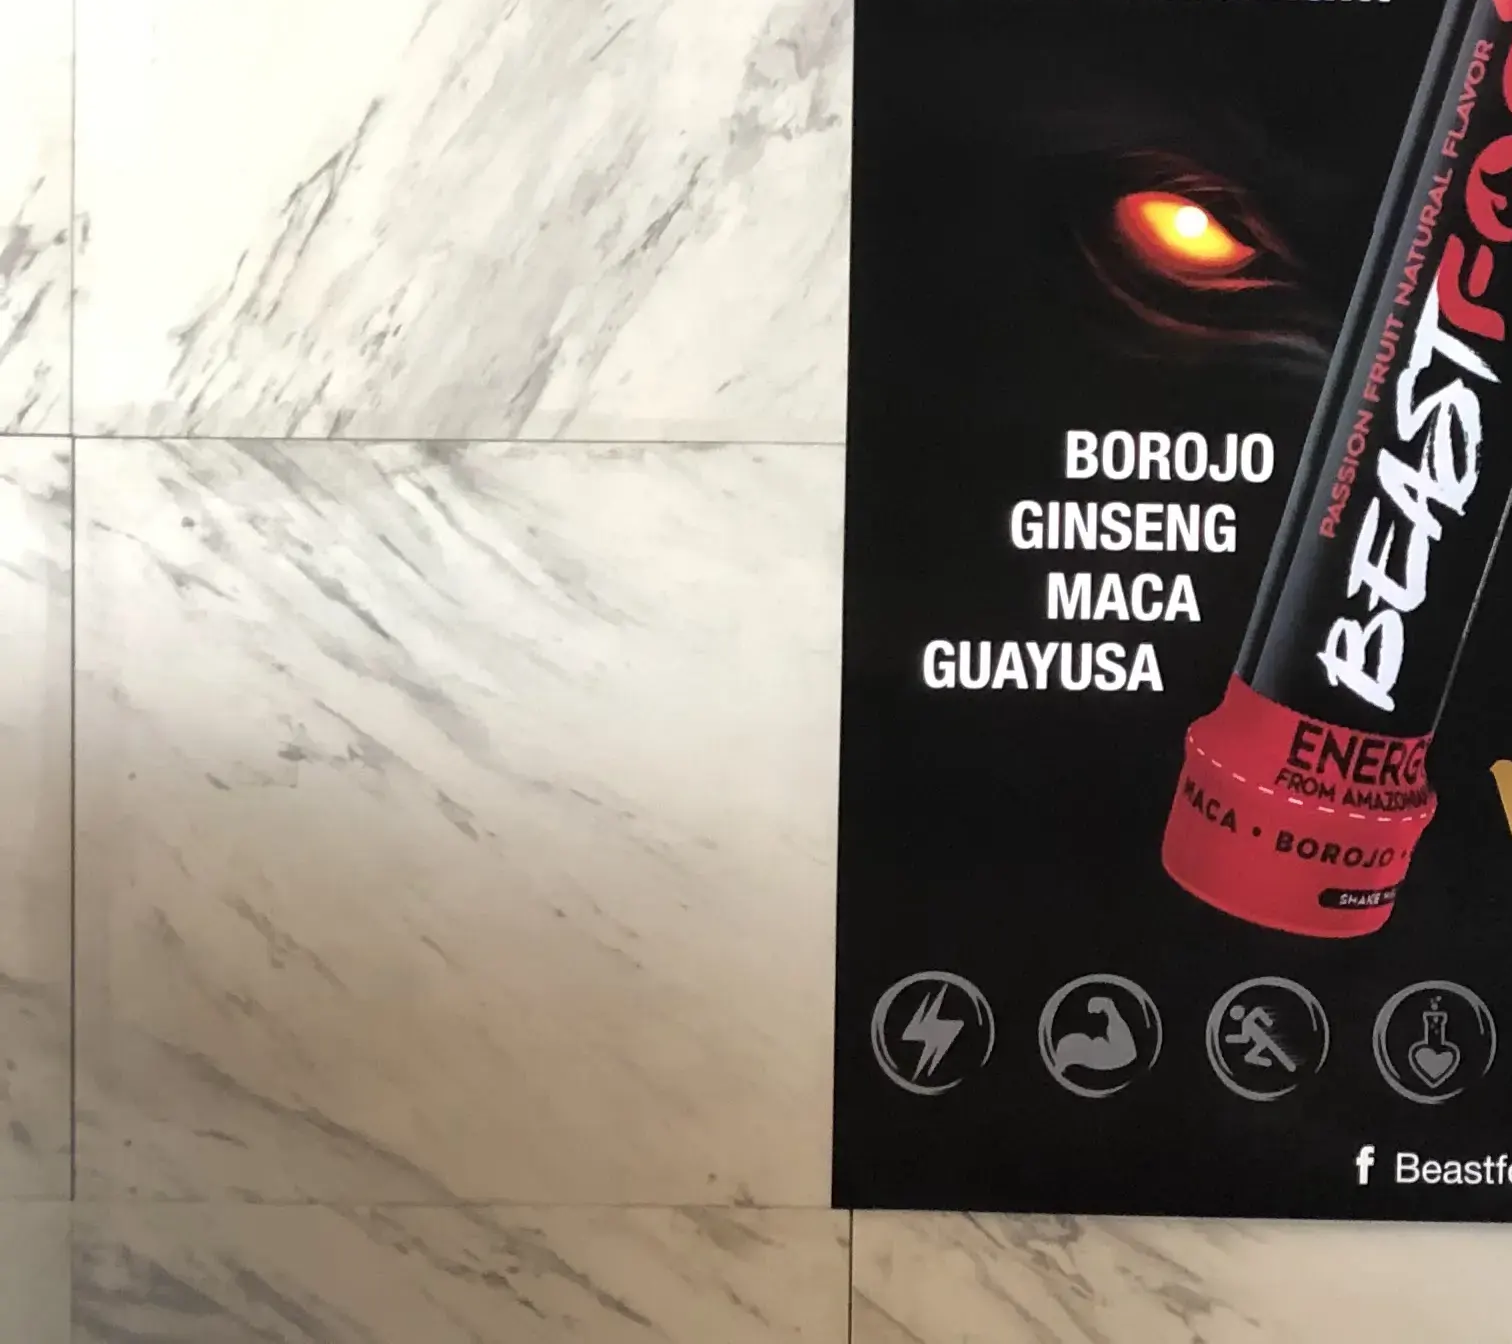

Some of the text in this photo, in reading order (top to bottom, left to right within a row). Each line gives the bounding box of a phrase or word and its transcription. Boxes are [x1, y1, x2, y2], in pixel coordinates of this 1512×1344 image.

[1319, 38, 1495, 539] PASSION FRUIT NATURAL FLAVOR
[1065, 429, 1274, 483] BOROJO
[1010, 499, 1237, 553] GINSENG
[1046, 571, 1201, 622] MACA
[922, 639, 1164, 692] GUAYUSA
[1286, 719, 1428, 786] ENERG
[1274, 767, 1336, 802] FROM
[1275, 829, 1396, 868] BOROJO
[1339, 892, 1381, 906] SHAKE
